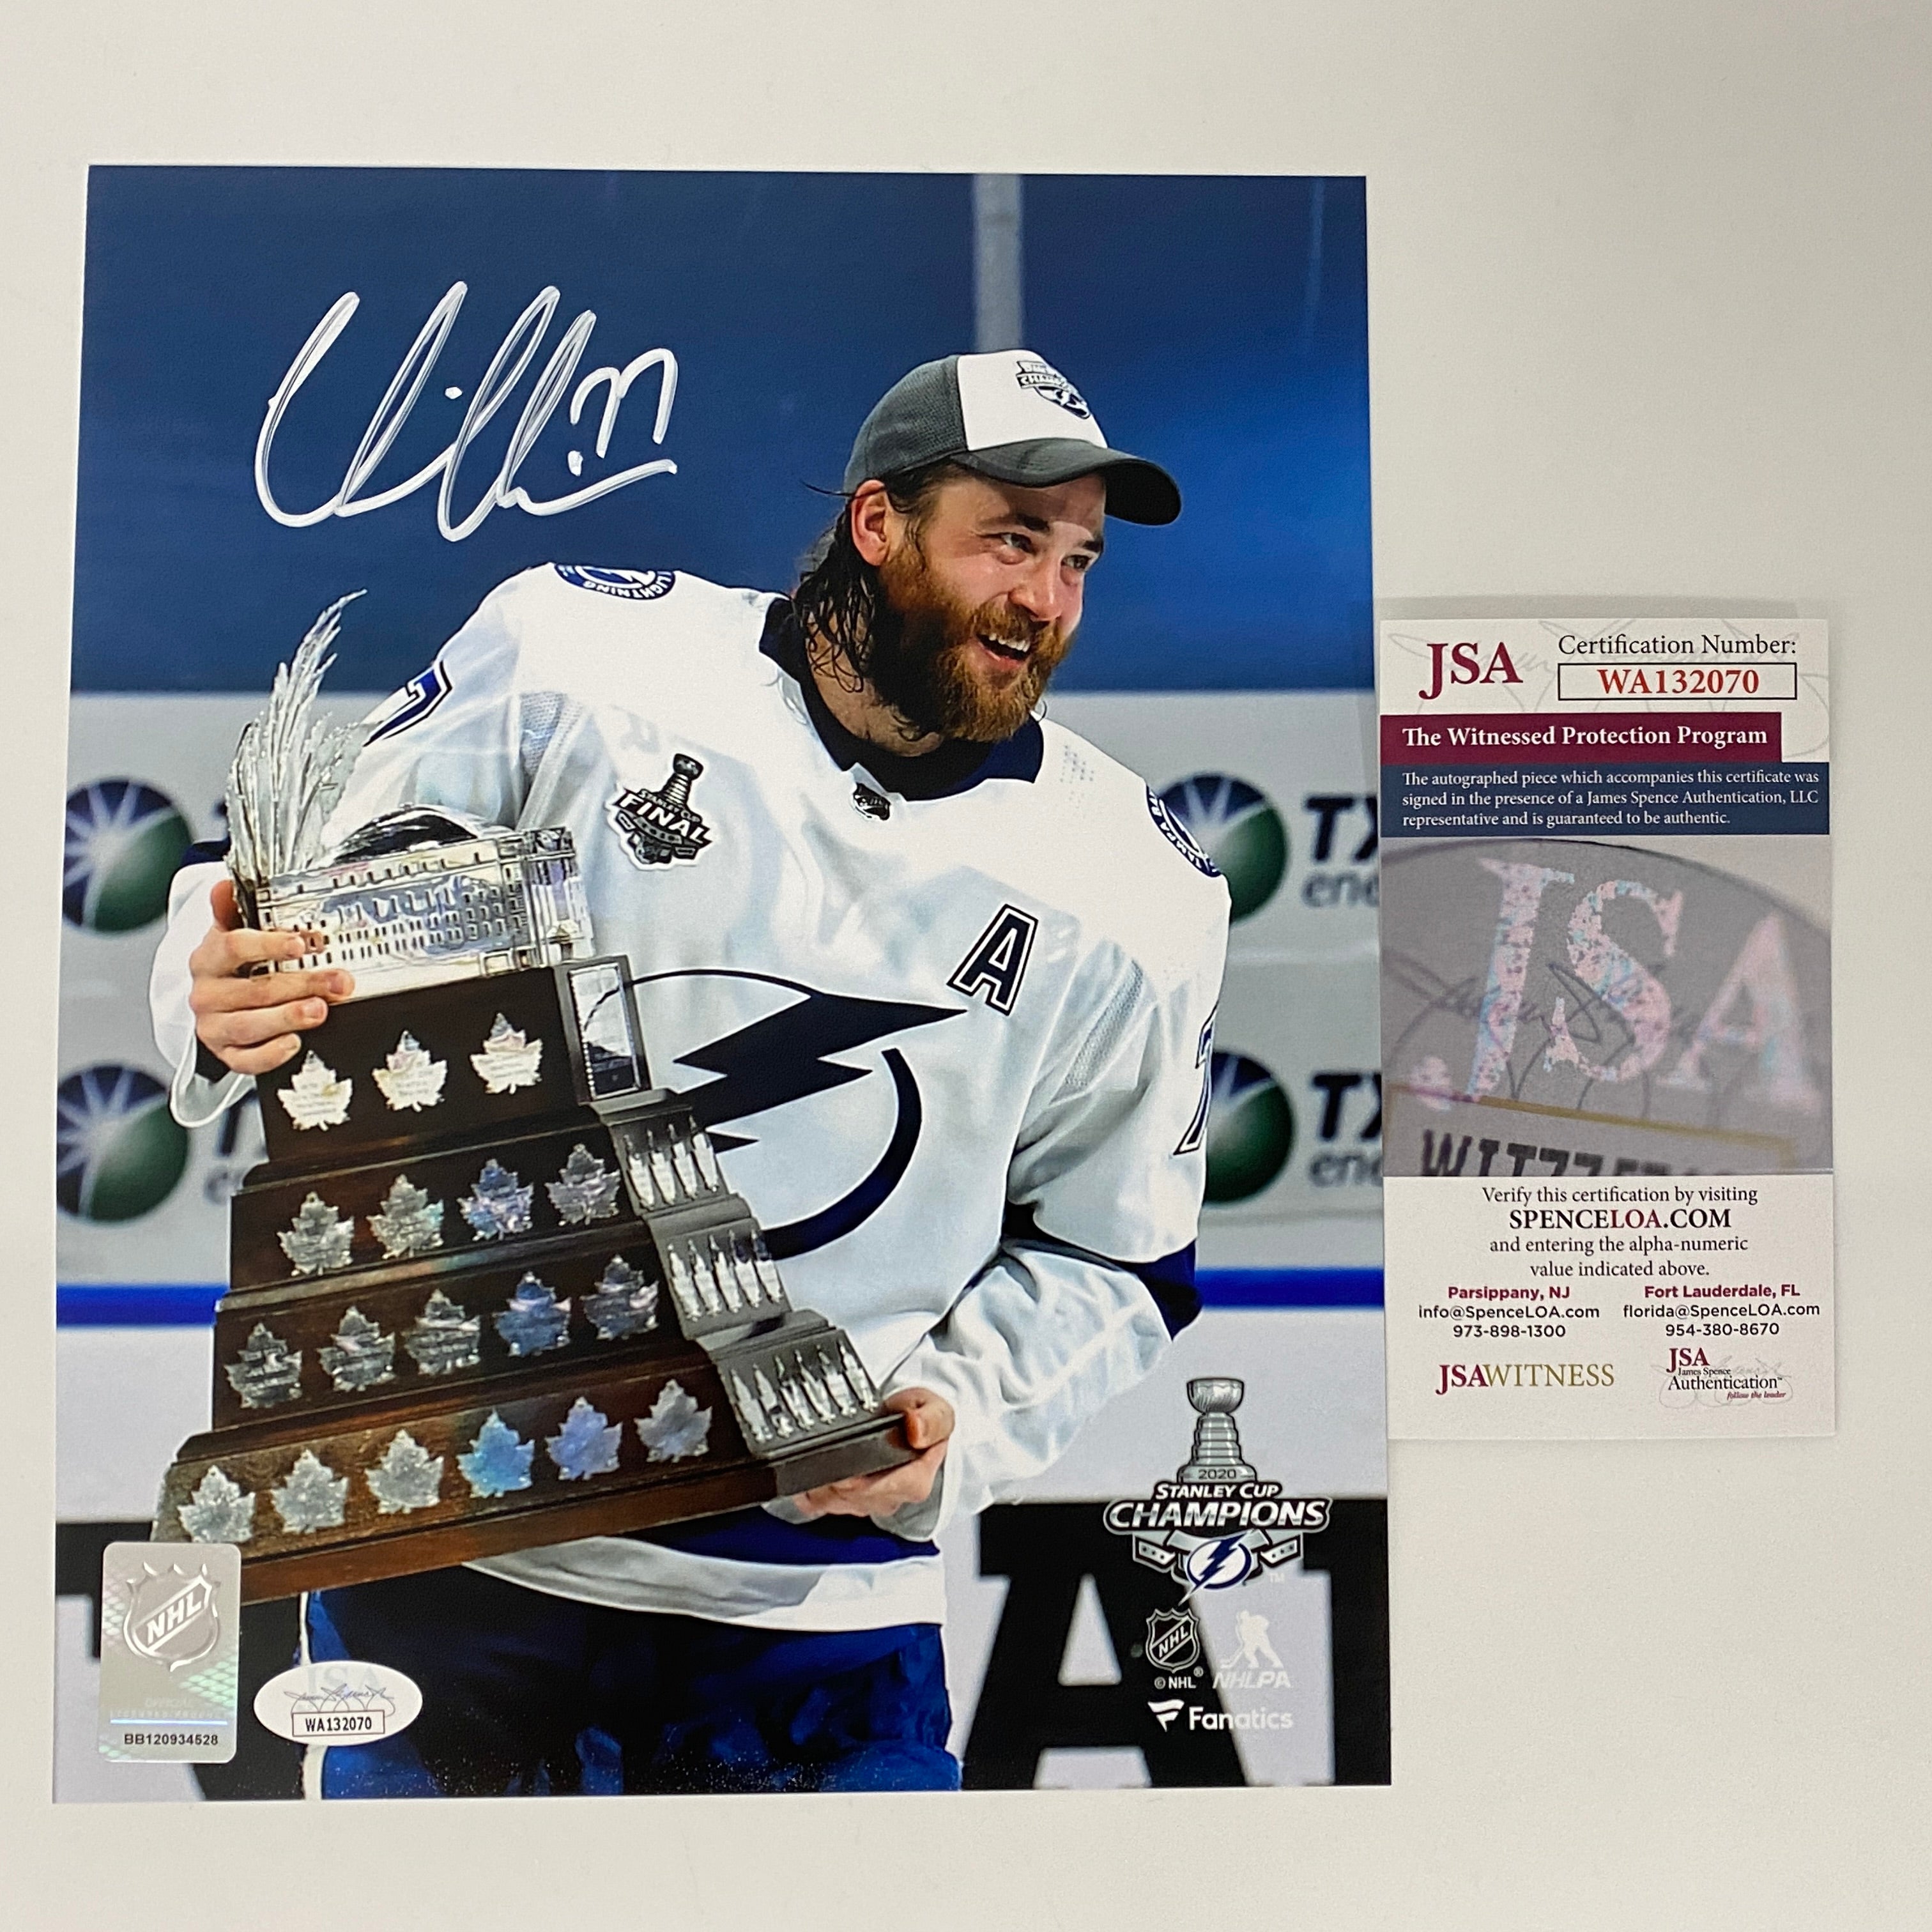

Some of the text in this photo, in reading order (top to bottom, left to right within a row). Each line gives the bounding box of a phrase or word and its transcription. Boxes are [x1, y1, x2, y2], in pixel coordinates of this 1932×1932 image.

[1558, 633, 1796, 655] Certification Number:
[1418, 641, 1524, 700] JSA
[1597, 669, 1759, 694] WA132070
[1402, 725, 1767, 749] The Witnessed Protection Program
[1402, 769, 1819, 789] The autographed piece which accompanies this certificate was
[1402, 790, 1818, 809] signed in the presence of a James Spence Authentication, LLC
[618, 792, 705, 844] FINAL
[1403, 810, 1730, 829] representative and is guaranteed to be authentic.
[946, 903, 1039, 1017] A
[1482, 1186, 1758, 1206] Verify this certification by visiting
[1509, 1208, 1731, 1229] SPENCELOA.COM
[1490, 1235, 1748, 1257] and entering the alpha-numeric
[1529, 1260, 1710, 1276] value indicated above.
[1448, 1286, 1570, 1301] Parsippany, NJ
[1644, 1284, 1800, 1299] Fort Lauderdale, FL
[1419, 1305, 1600, 1321] info@SpenceLOA.com
[1623, 1303, 1820, 1319] florida@SpenceLOA.com
[1453, 1324, 1566, 1338] 973-898-1300
[1666, 1322, 1779, 1337] 954-380-8670
[1666, 1347, 1711, 1374] JSA
[1678, 1367, 1731, 1377] James Spence
[1198, 1468, 1237, 1480] 2020
[1154, 1482, 1280, 1499] STANLEY CUP
[1108, 1500, 1326, 1528] CHAMPIONS
[146, 1593, 203, 1645] NHL
[1157, 1625, 1190, 1659] NHL
[1211, 1670, 1292, 1690] NHLPA
[305, 1715, 373, 1733] WA132070
[1188, 1706, 1294, 1731] Fanatics
[123, 1733, 219, 1746] BB120934528
